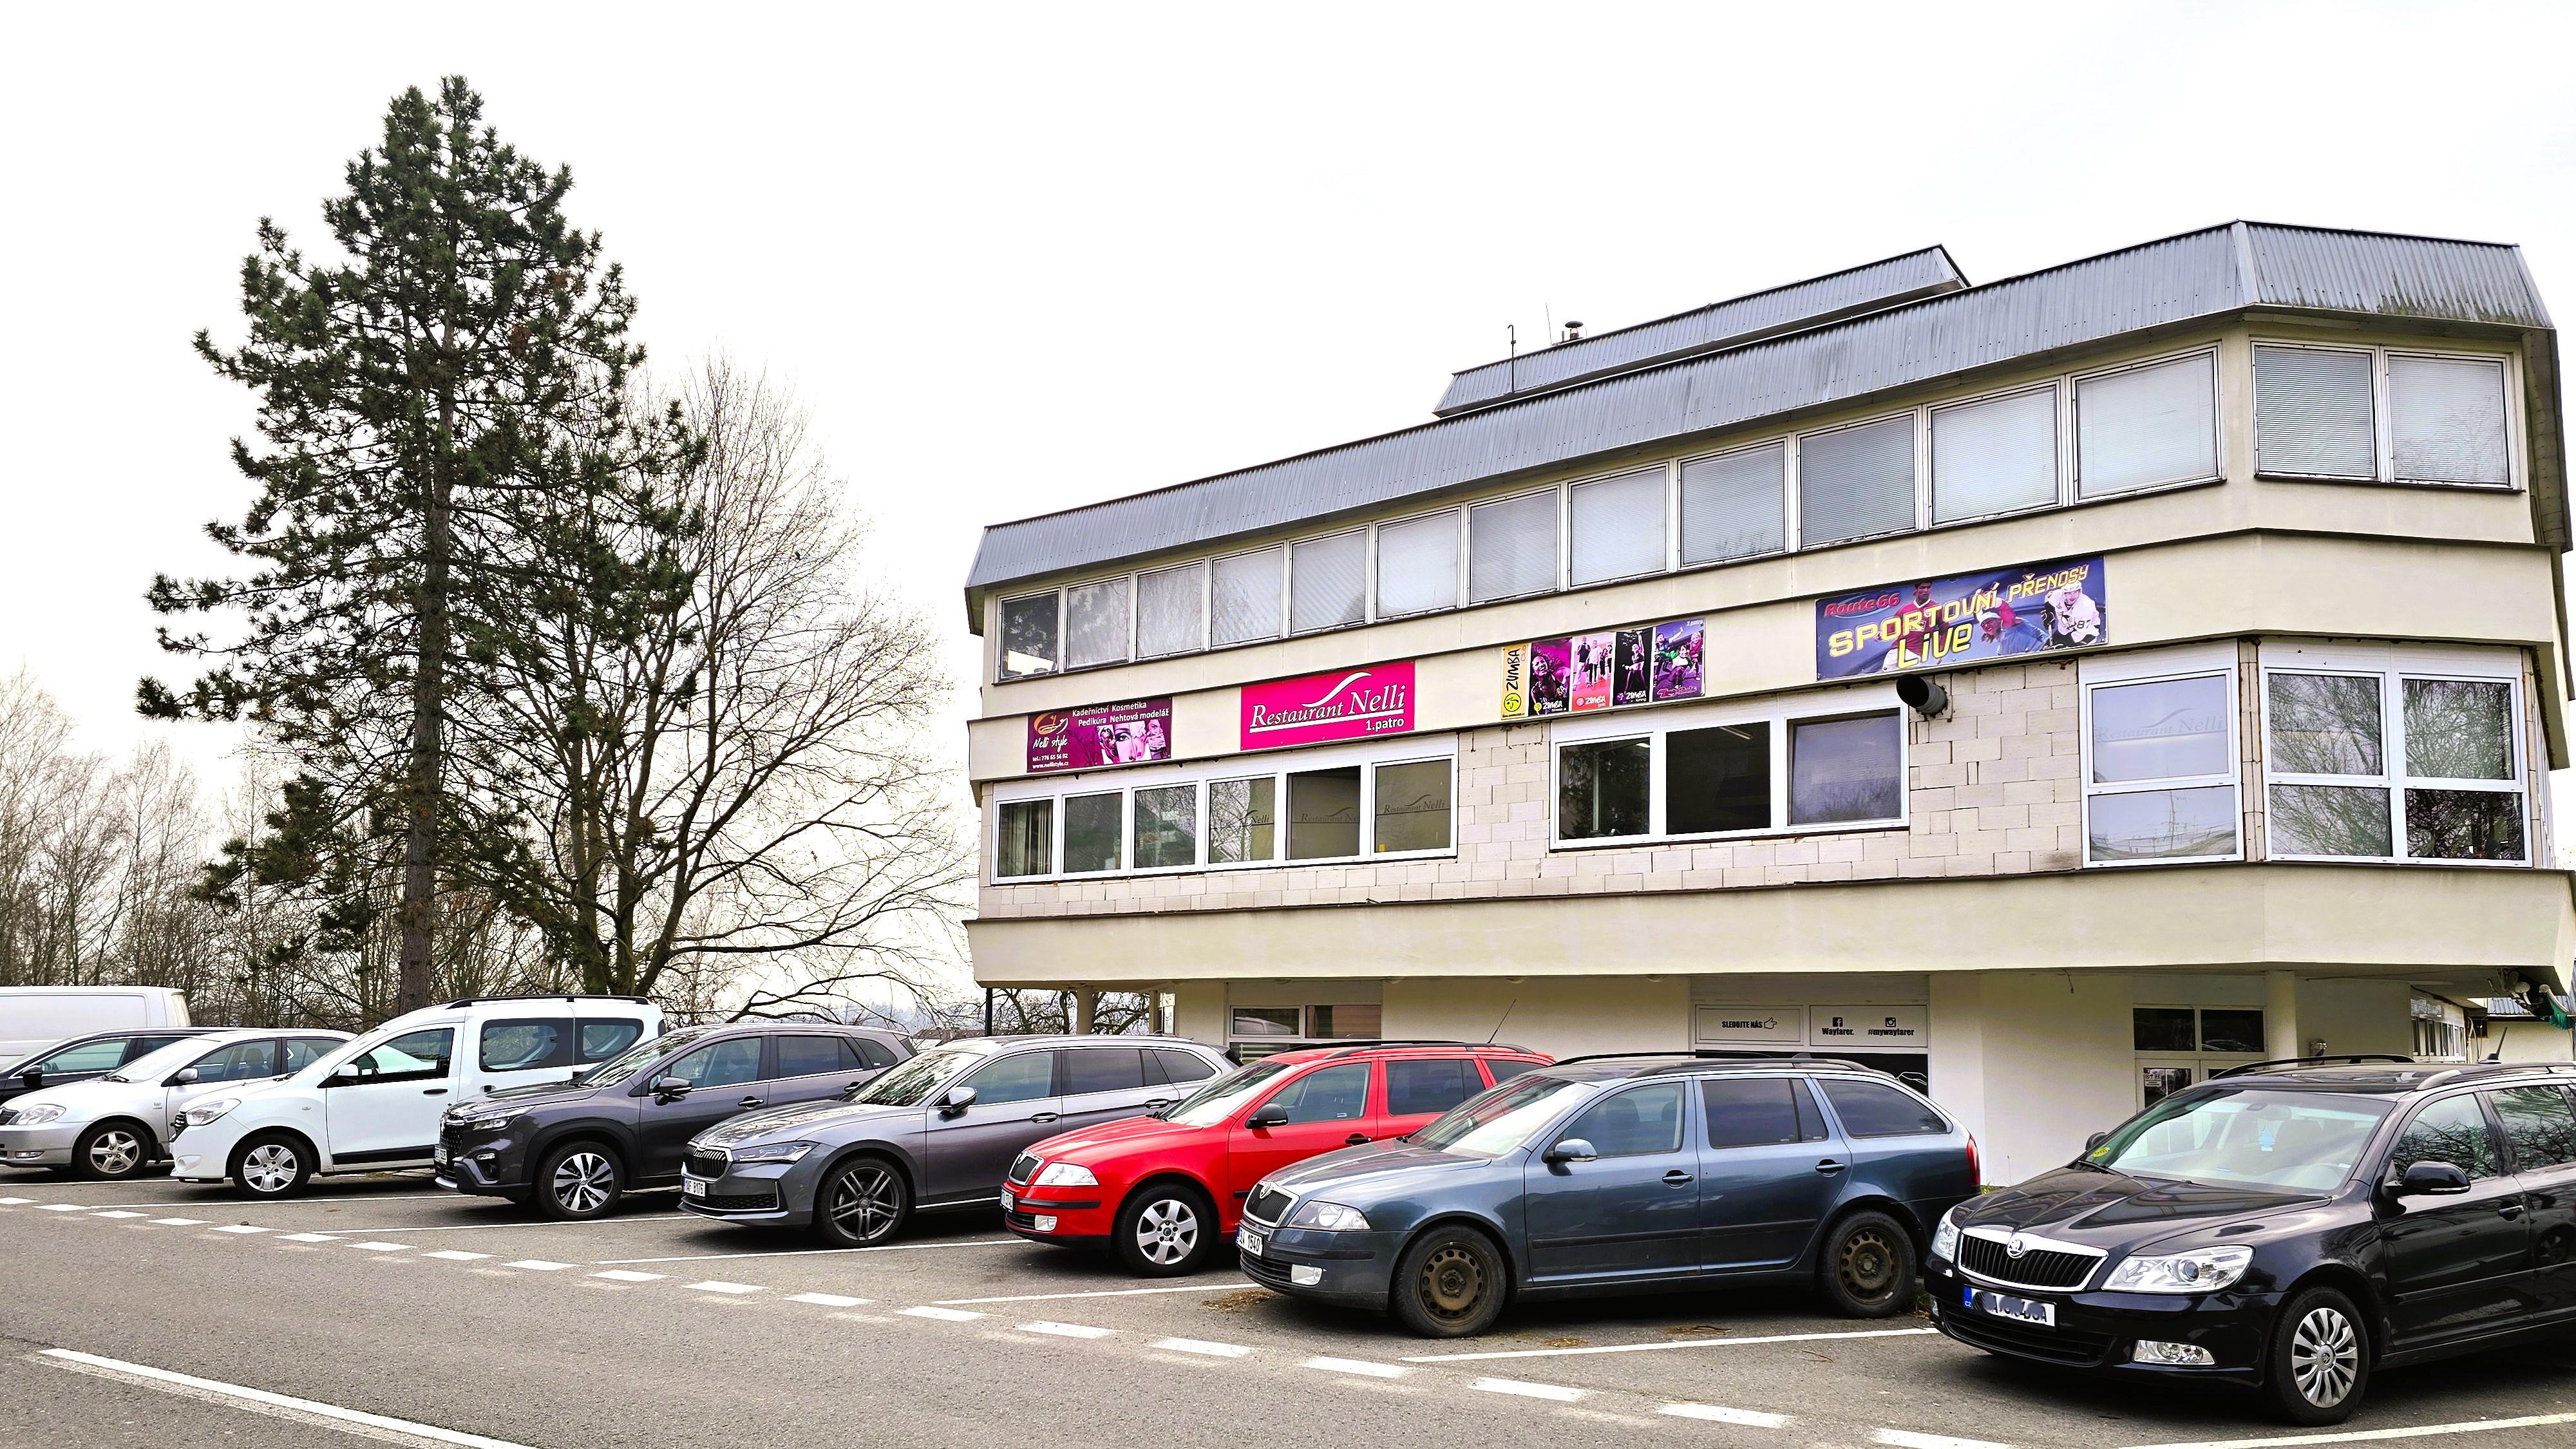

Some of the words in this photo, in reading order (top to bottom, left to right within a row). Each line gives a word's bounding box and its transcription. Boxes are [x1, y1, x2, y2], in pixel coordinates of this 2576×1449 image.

[1829, 582, 2000, 658] SPORTOVNÍ
[2007, 564, 2089, 603] PŘENOSY
[2077, 620, 2090, 629] 87
[1506, 648, 1520, 692] ZUMBA
[1585, 695, 1606, 705] ZUMBA
[1625, 690, 1647, 700] ZUMBA
[1072, 706, 1109, 717] Kadeřnictví
[1112, 701, 1147, 712] Kosmetika
[1249, 701, 1344, 728] Restaurant
[1348, 684, 1406, 715] Nelli
[1542, 701, 1563, 710] ZUMBA
[1078, 717, 1106, 726] Pedikúra
[1110, 713, 1138, 723] Nehtová
[1140, 708, 1169, 719] modeláž
[1365, 717, 1405, 732] 1.patro
[2097, 725, 2173, 739] Restaurant
[2179, 715, 2223, 733] Nelli
[1032, 737, 1049, 749] Nelli
[1051, 735, 1068, 753] style
[1385, 804, 1421, 813] Restaurant
[1423, 799, 1444, 810] Nelli
[1301, 813, 1342, 822] Restaurant
[1750, 1020, 1763, 1028] NÁS
[1248, 1234, 1260, 1253] 1540
